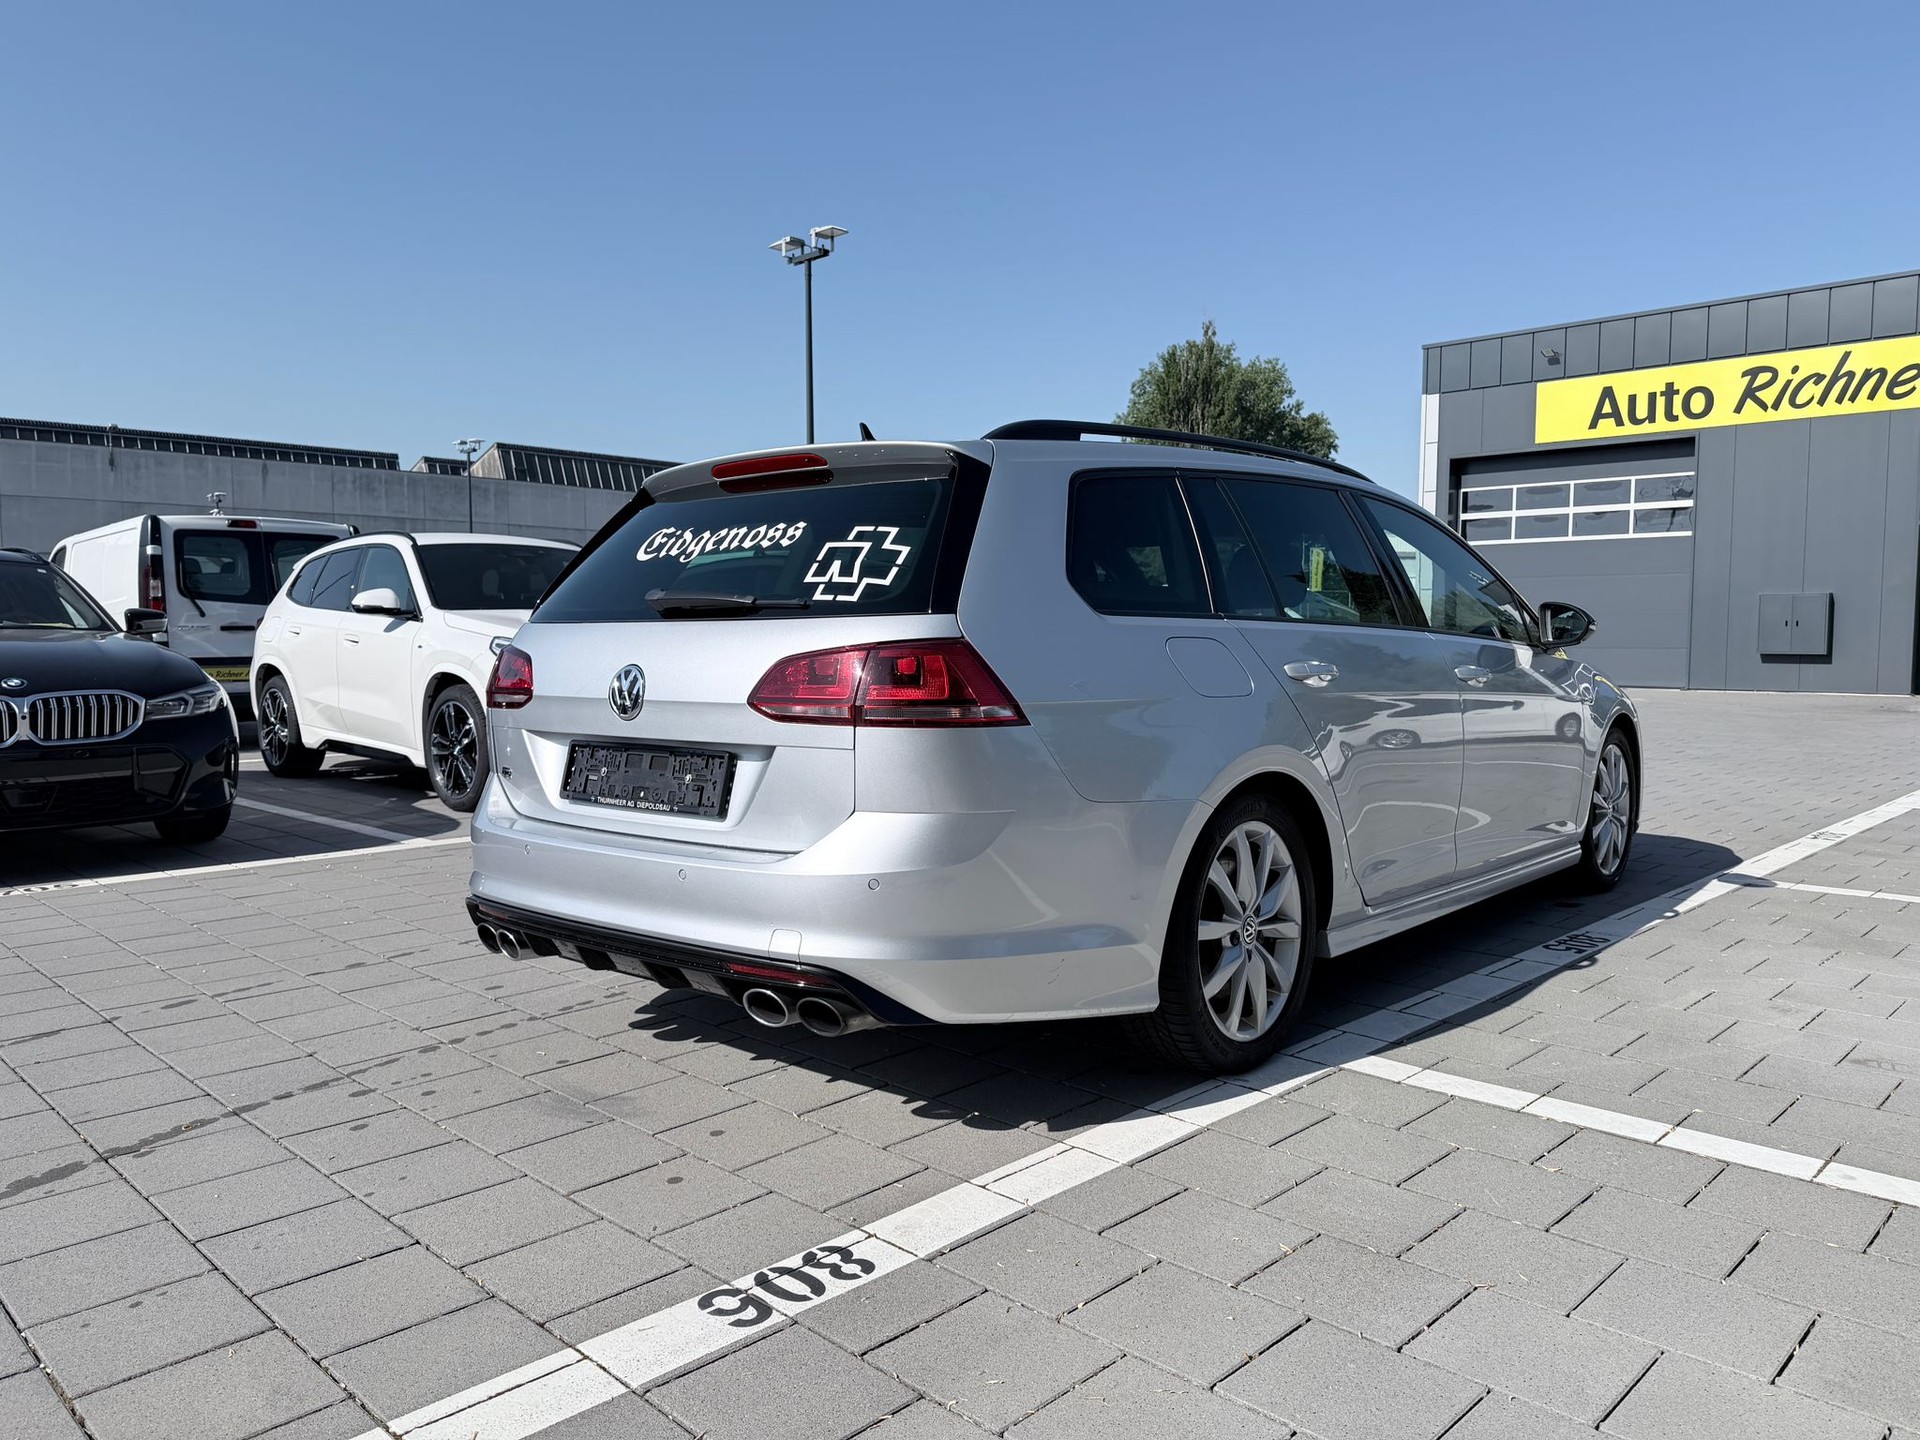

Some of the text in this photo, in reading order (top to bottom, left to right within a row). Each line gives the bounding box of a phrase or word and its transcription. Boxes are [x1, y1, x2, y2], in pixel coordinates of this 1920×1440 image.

[1588, 382, 1715, 430] Auto
[636, 521, 807, 563] Eidgenoss
[597, 796, 671, 811] THURNHEER AG DIEPOLDSAU
[697, 1245, 876, 1328] 908
